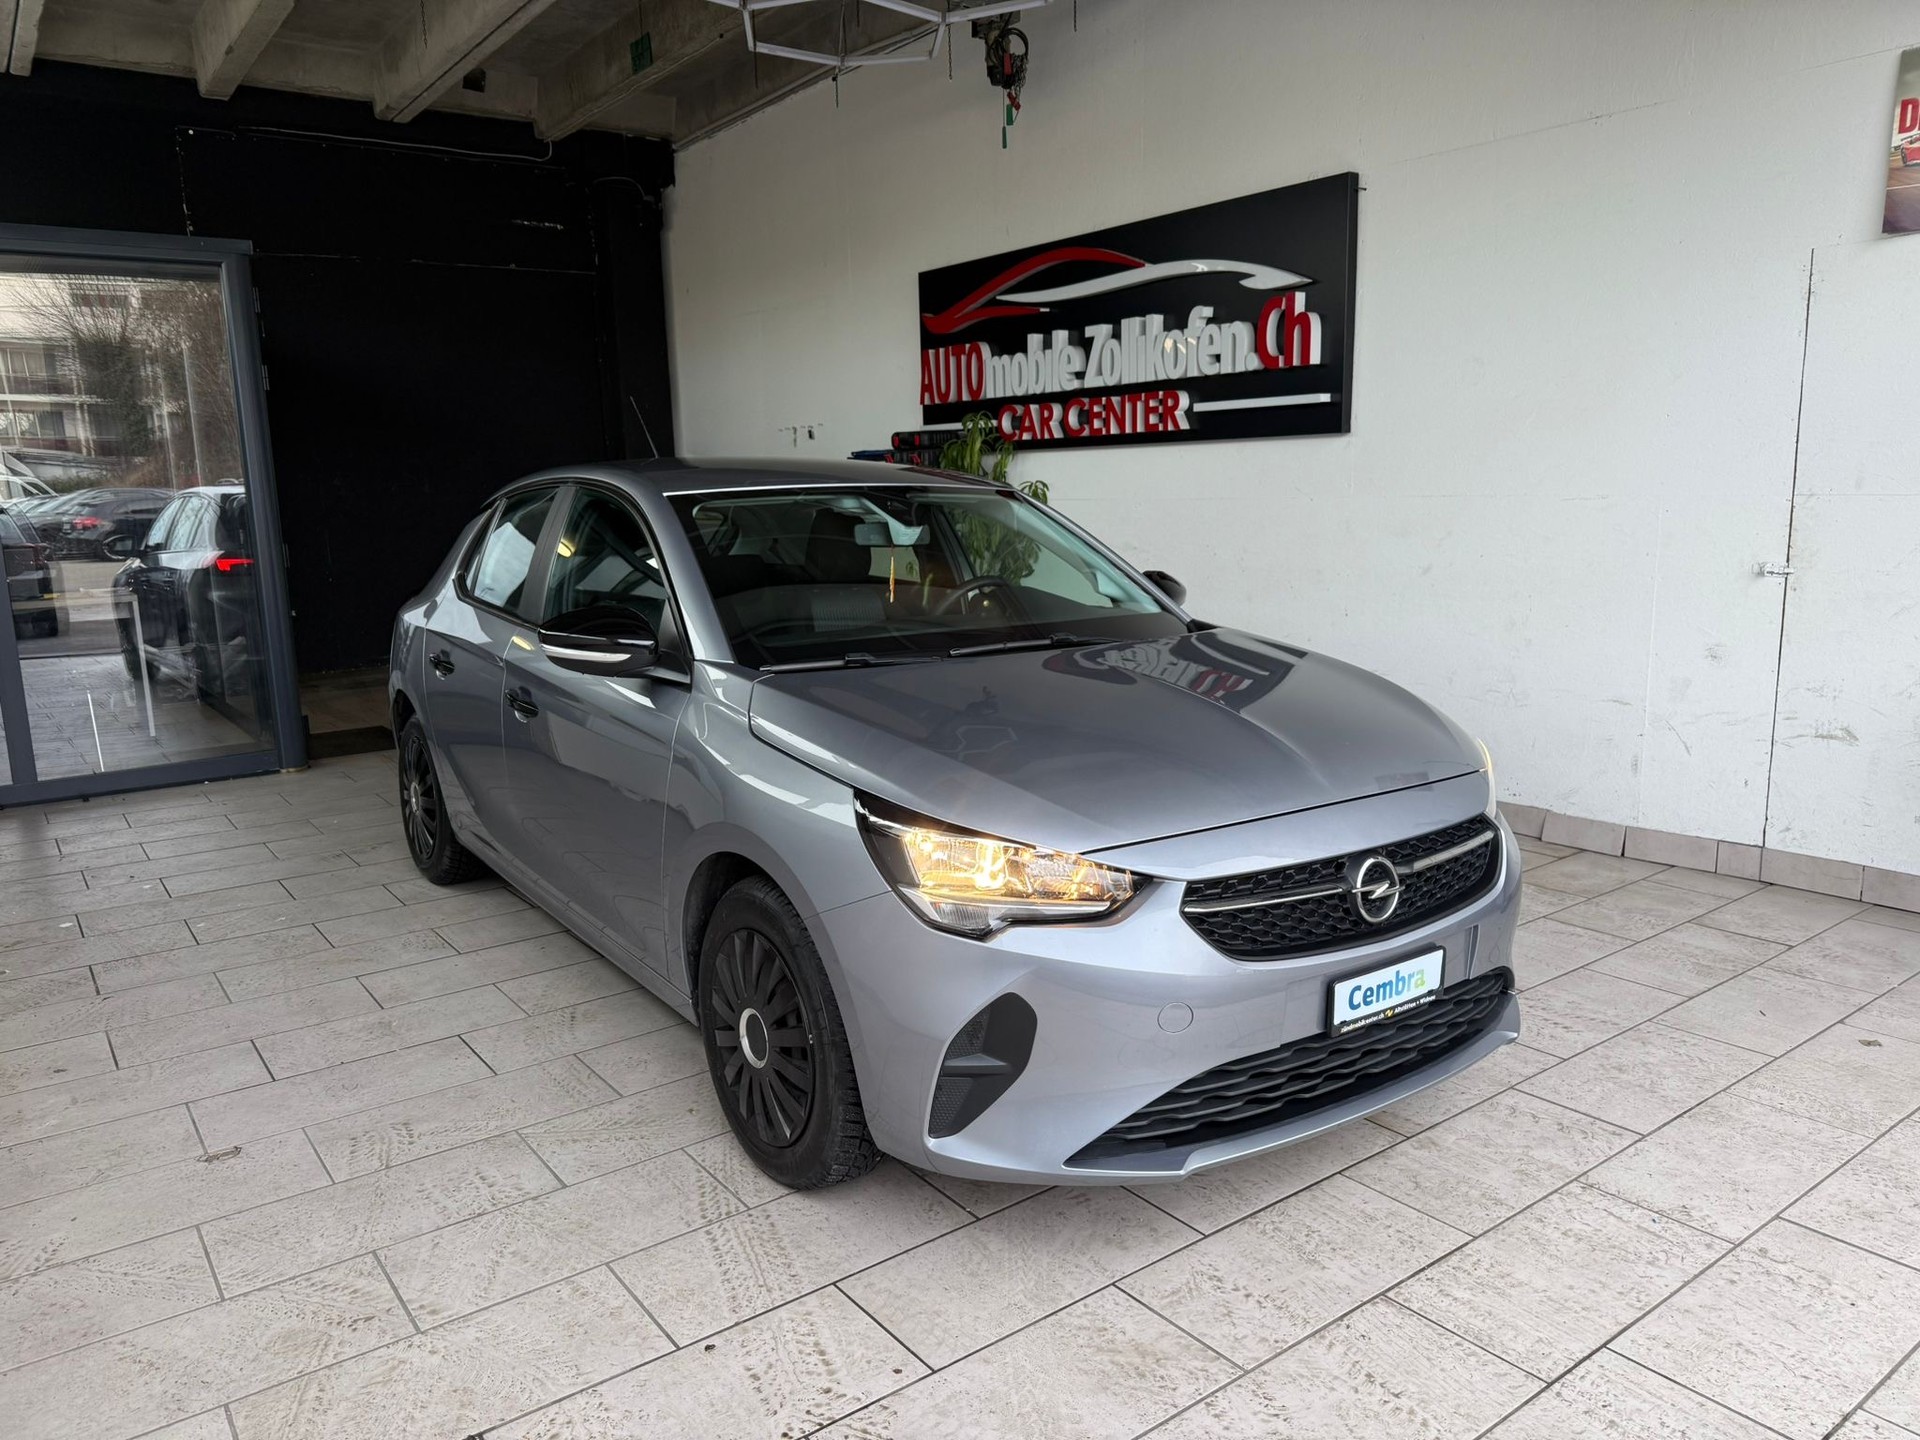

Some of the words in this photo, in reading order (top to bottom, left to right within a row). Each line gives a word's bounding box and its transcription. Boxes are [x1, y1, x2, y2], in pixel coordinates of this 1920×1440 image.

[1898, 97, 1920, 134] D
[998, 402, 1063, 441] CAR
[1064, 390, 1190, 437] CENTER
[1348, 969, 1426, 1011] Cembra
